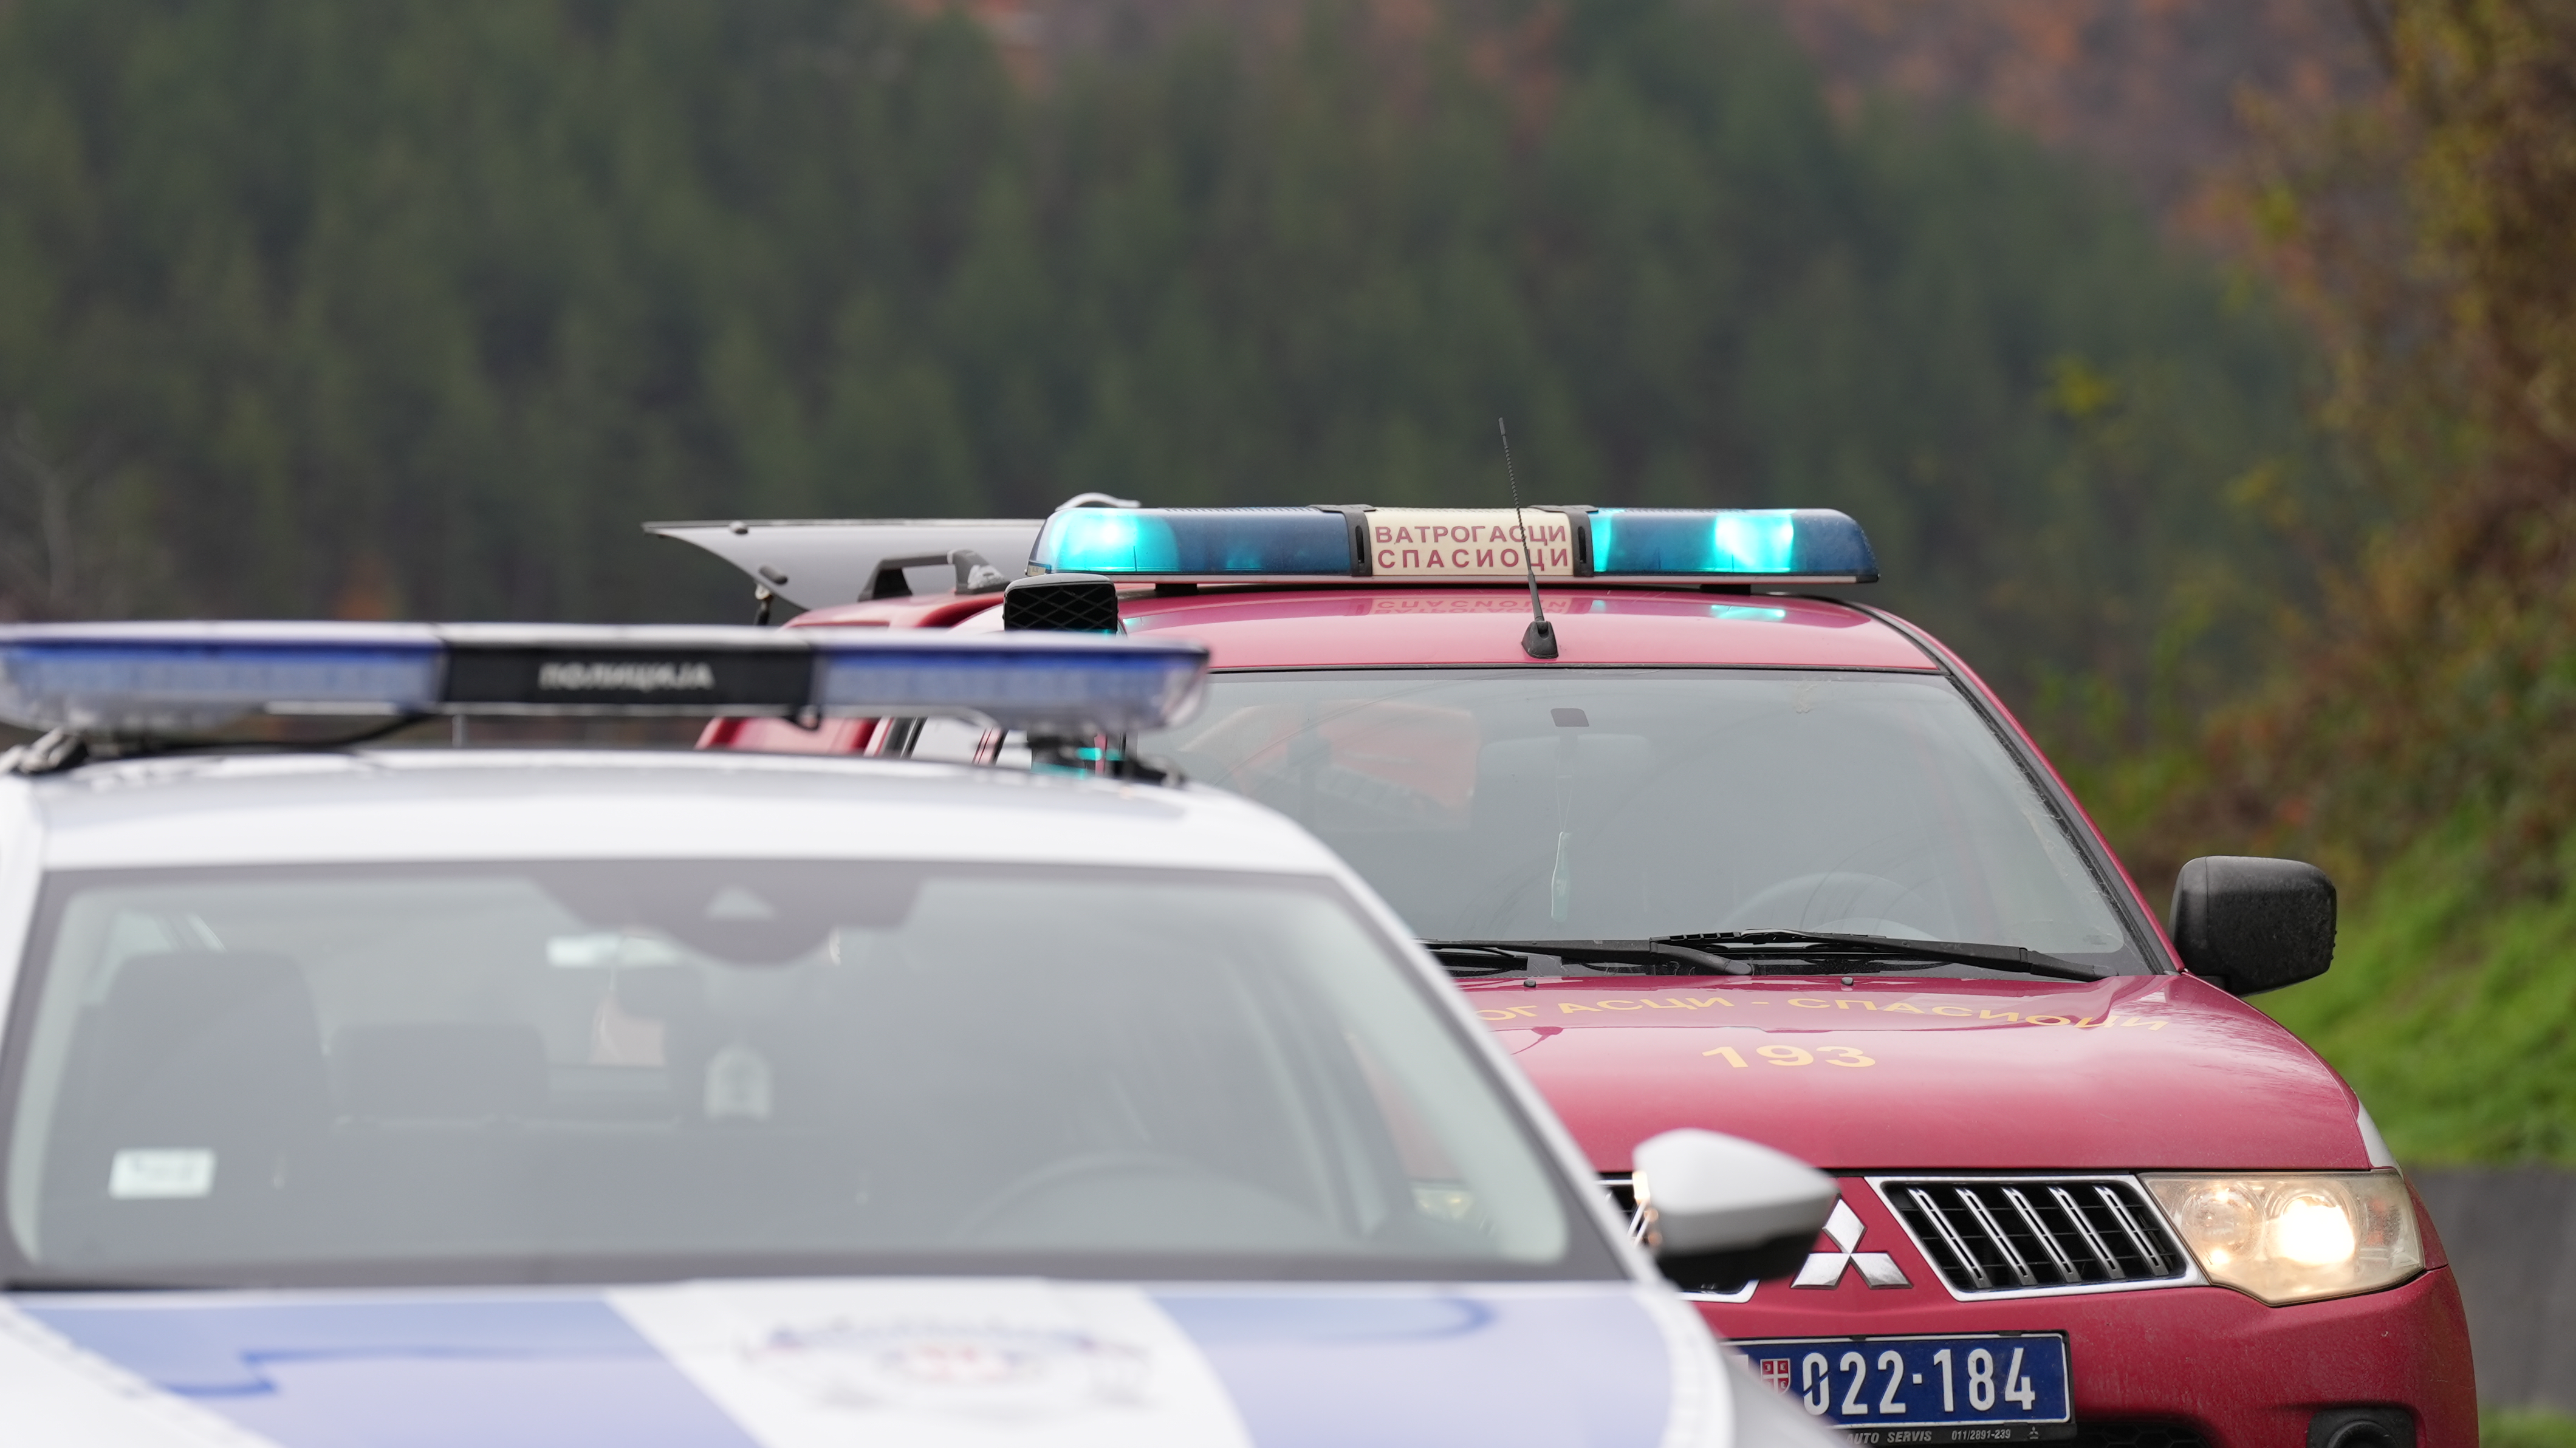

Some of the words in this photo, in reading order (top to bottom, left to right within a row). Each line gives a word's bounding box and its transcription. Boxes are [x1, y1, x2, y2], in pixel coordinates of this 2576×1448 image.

[1375, 526, 1566, 546] ВАТРОГАСЦИ
[1377, 548, 1568, 572] СПАСИОЦИ
[1787, 998, 2170, 1031] СПАСИОЦИ
[1702, 1045, 1876, 1068] 193
[1886, 1430, 1933, 1443] SERVIS
[1951, 1429, 2011, 1441] 011/2891-239
